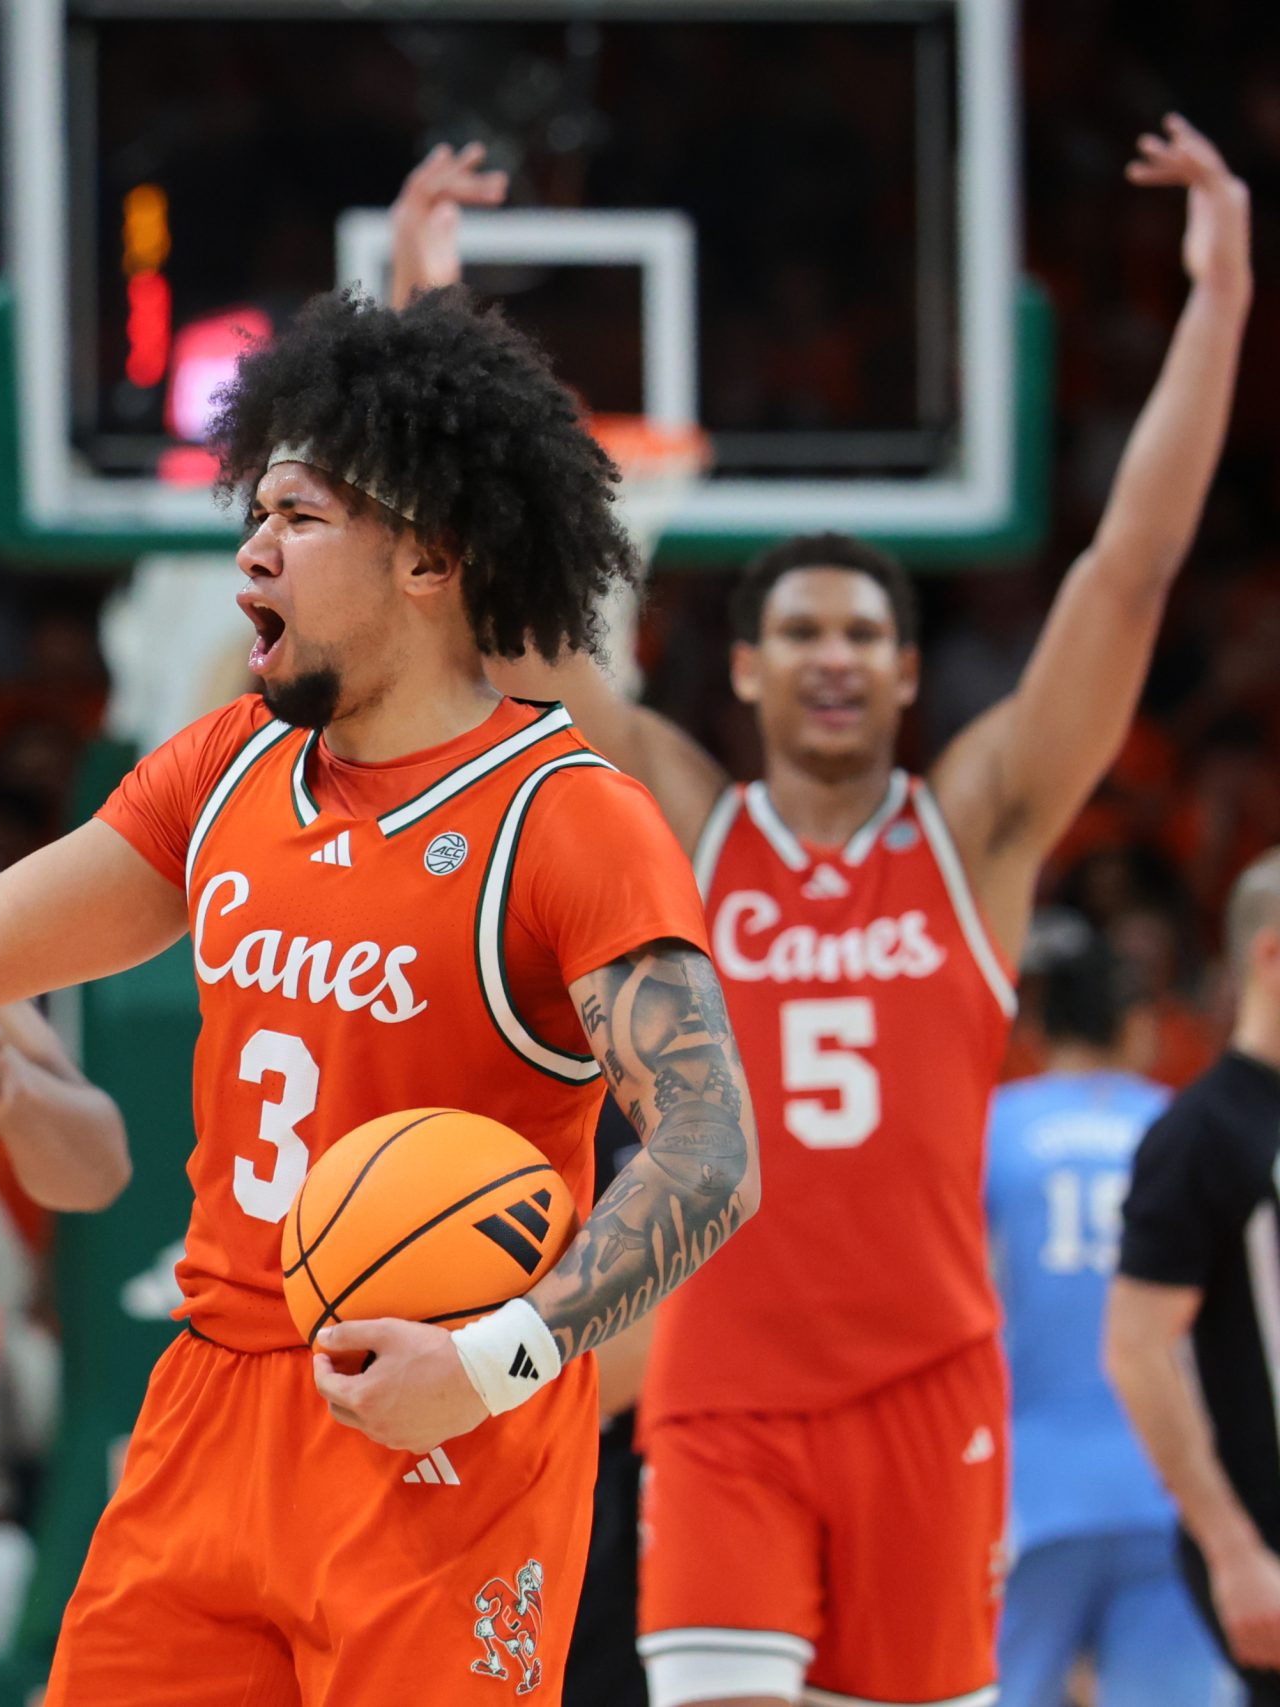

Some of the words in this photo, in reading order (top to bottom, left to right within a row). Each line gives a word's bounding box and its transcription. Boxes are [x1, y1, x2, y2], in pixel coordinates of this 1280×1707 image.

[431, 845, 465, 859] ACC
[193, 870, 428, 1024] Canes
[713, 889, 947, 983] Canes
[232, 1028, 320, 1224] 3
[780, 996, 881, 1150] 5
